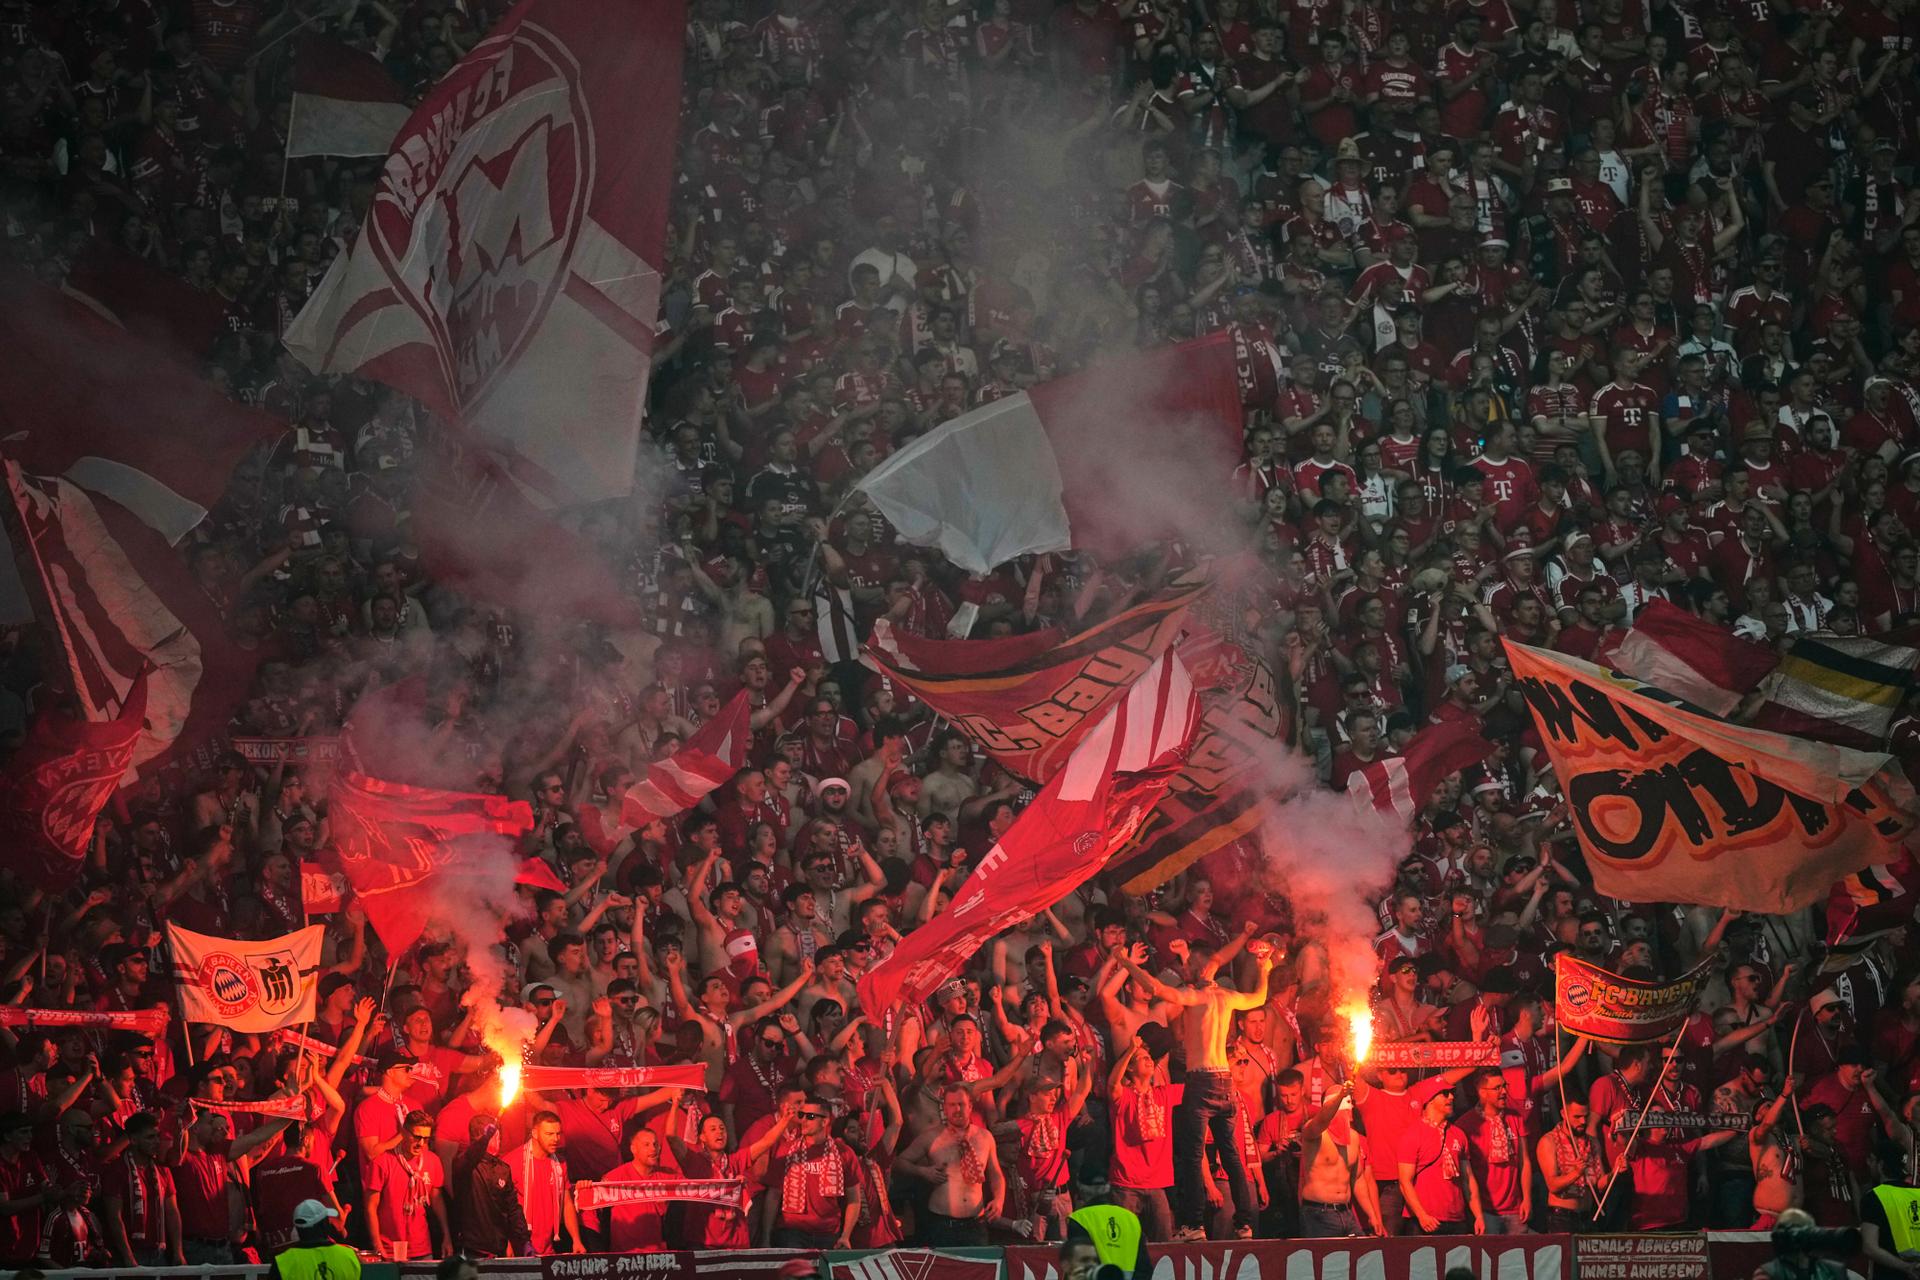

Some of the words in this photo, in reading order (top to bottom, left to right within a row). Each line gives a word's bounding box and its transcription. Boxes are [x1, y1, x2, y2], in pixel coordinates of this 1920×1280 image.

[1374, 166, 1387, 182] T
[1603, 166, 1618, 182] T
[1580, 200, 1594, 214] T
[1623, 407, 1641, 426] T
[1424, 485, 1437, 502] T
[1494, 480, 1513, 501] T
[1623, 979, 1697, 1007] BAYER
[1577, 1238, 1634, 1254] NIEMALS
[1636, 1238, 1705, 1254] ABWESEND
[550, 1257, 580, 1277] STAY
[616, 1255, 645, 1274] STAY
[1579, 1263, 1627, 1280] IMMER
[1630, 1263, 1704, 1280] ANWESEND
